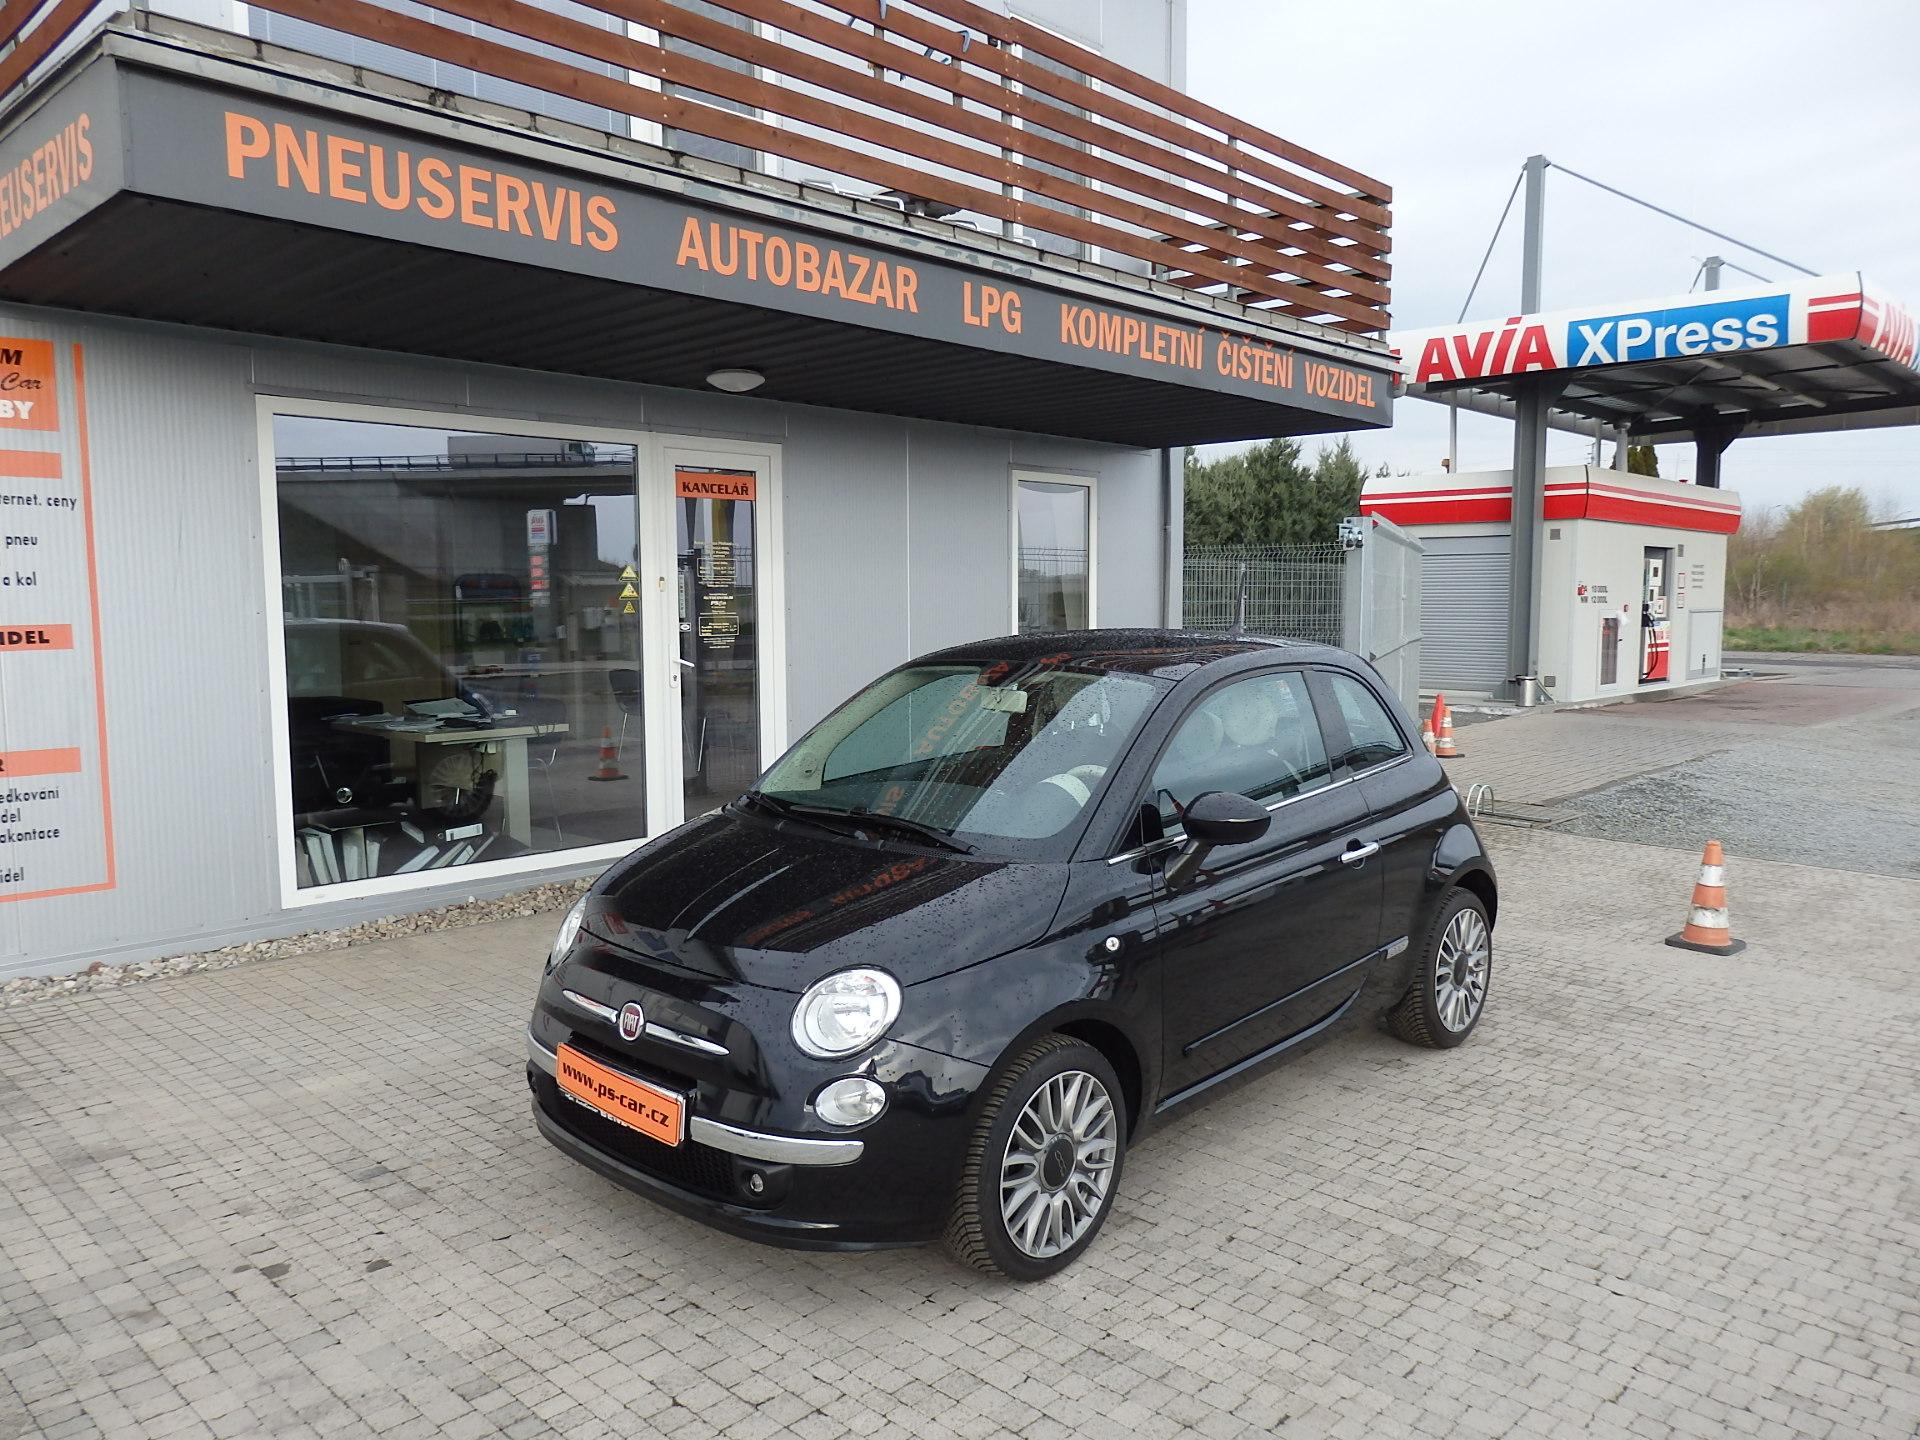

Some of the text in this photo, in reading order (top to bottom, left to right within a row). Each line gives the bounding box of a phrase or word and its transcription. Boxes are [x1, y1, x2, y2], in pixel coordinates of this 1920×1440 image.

[225, 112, 1377, 408] PNEUSERVIS AUTOBAZAR LPG KOMPLETNÍ ČIŠTĚNÍ VOZIDEL
[1576, 314, 1779, 367] XPress
[1, 372, 42, 391] Car
[0, 400, 34, 419] BY
[682, 482, 749, 496] KANCELÁŘ
[0, 494, 77, 511] ernet. ceny
[6, 536, 38, 549] pneu
[3, 571, 37, 586] a kol
[562, 1062, 669, 1128] www.ps-car.cz
